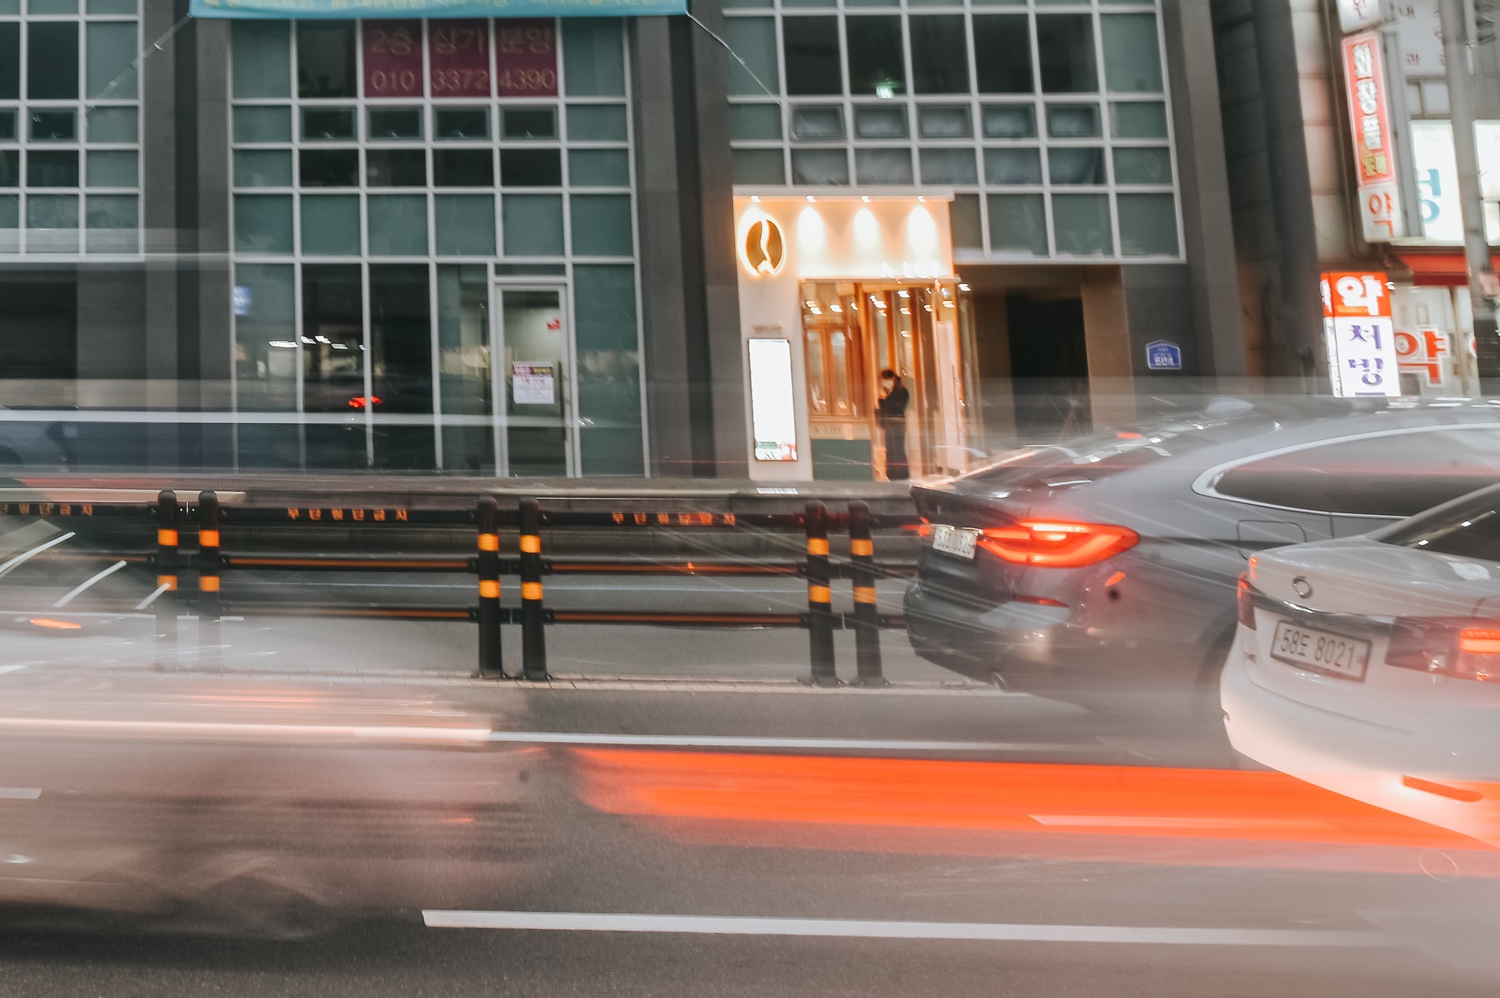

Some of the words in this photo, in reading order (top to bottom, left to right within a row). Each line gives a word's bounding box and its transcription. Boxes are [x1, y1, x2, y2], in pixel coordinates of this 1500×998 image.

[371, 69, 416, 92] 010
[431, 68, 488, 91] 3372
[499, 67, 557, 91] 4390
[1337, 275, 1384, 315] 약
[1313, 636, 1354, 670] 8021
